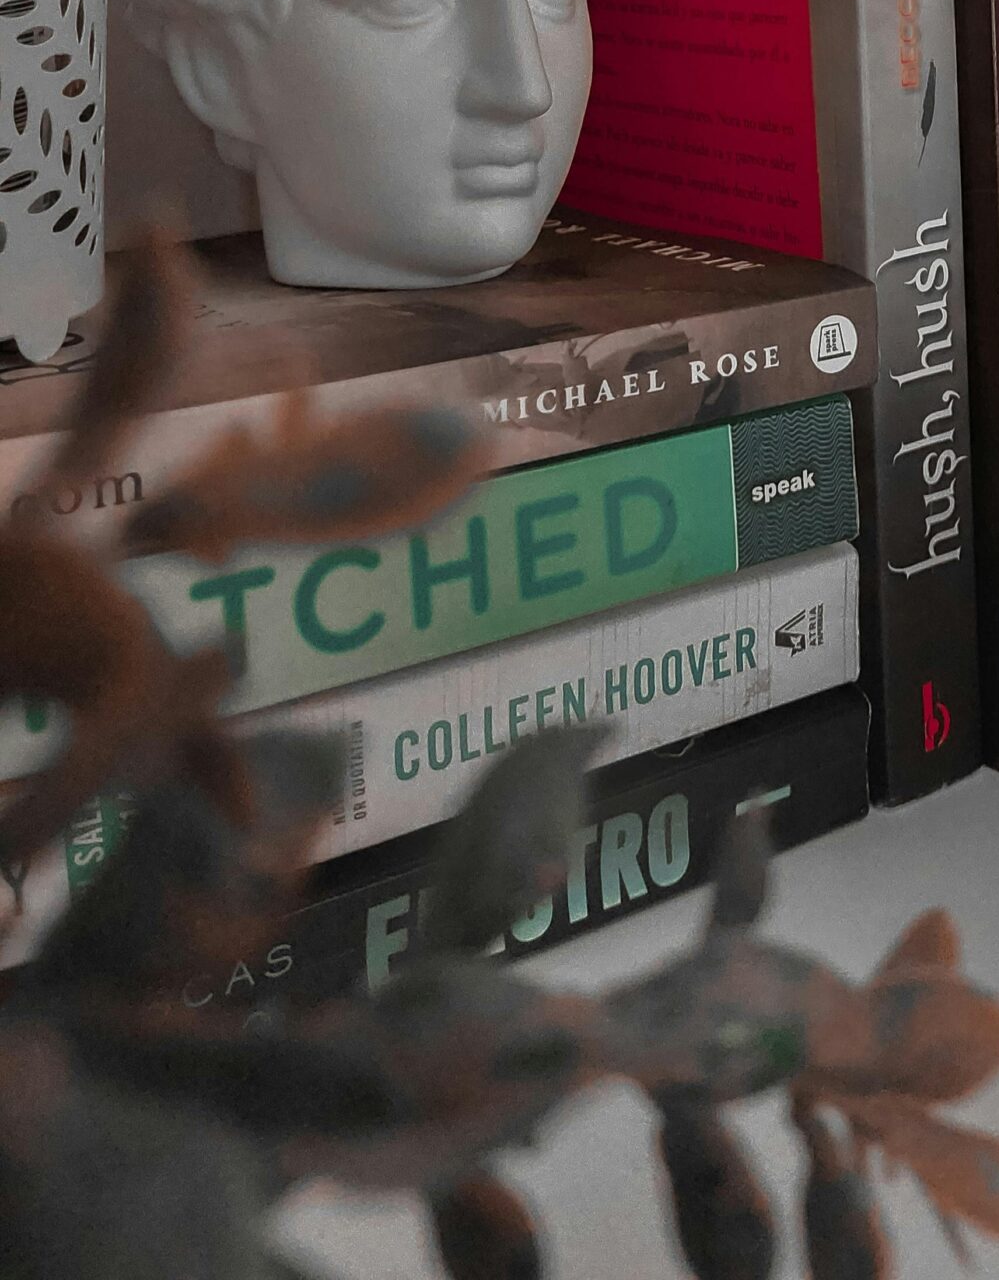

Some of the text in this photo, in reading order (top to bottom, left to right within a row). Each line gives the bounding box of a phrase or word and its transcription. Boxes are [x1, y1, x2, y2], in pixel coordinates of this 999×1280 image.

[591, 233, 766, 272] MICHAEL
[481, 343, 784, 425] MICHAEL ROSE
[875, 210, 969, 580] hush, hush
[750, 467, 816, 503] speak
[808, 606, 817, 647] ATRIA
[393, 623, 760, 784] COLLEEN HOOVER
[349, 719, 367, 821] OR QUOTATION
